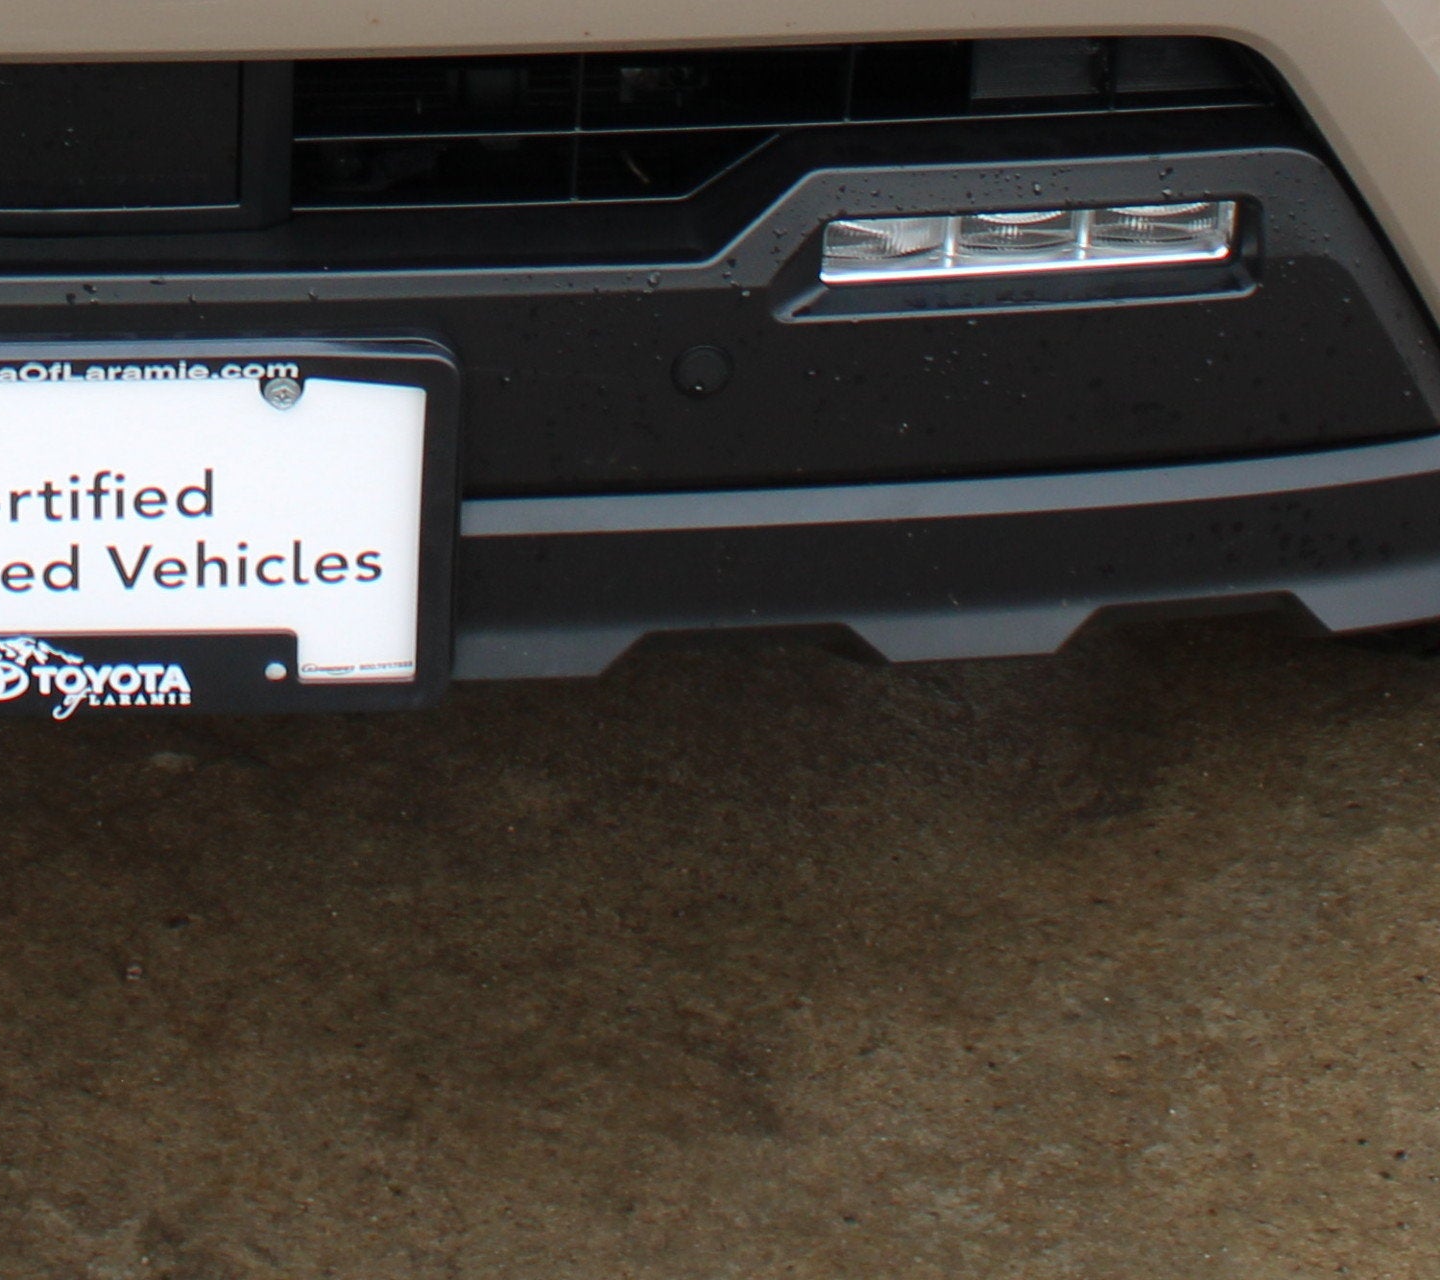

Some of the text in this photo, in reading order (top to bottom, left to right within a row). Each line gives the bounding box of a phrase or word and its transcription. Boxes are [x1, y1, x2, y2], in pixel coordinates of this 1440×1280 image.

[105, 538, 384, 590] Vehicles
[31, 663, 193, 696] TOYOTA
[89, 693, 193, 707] LARAMIE
